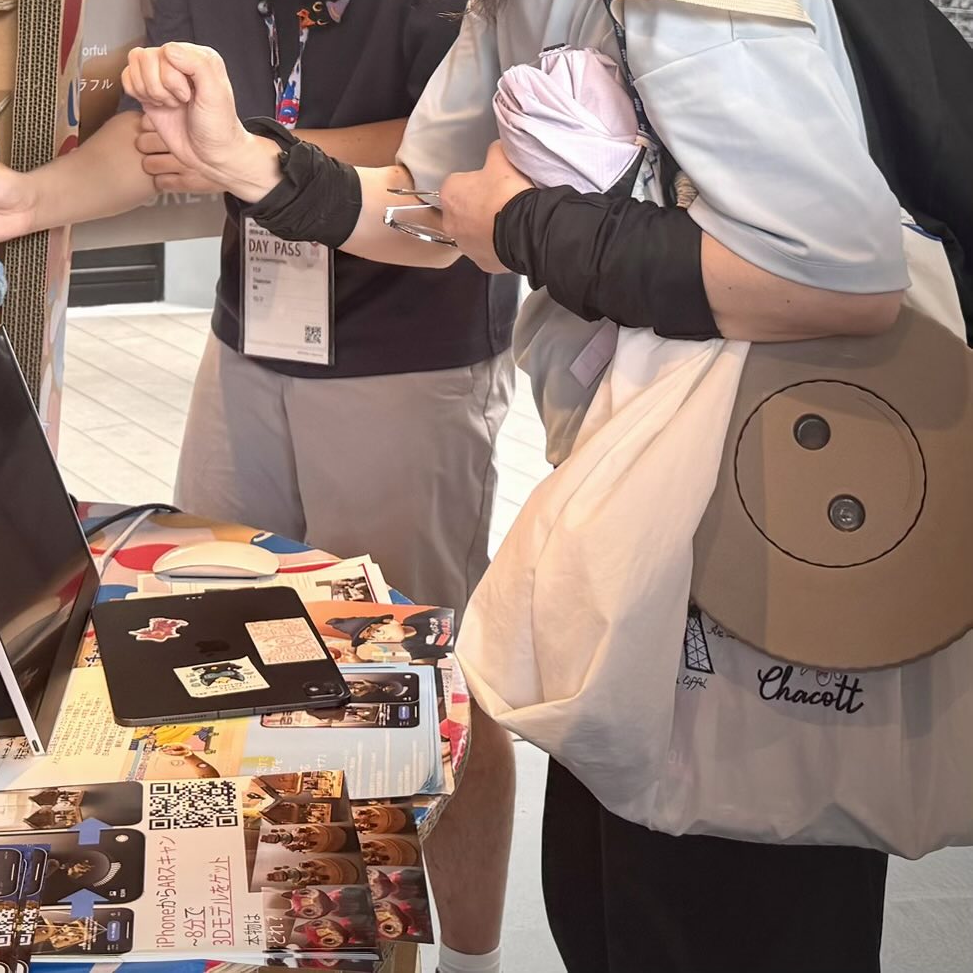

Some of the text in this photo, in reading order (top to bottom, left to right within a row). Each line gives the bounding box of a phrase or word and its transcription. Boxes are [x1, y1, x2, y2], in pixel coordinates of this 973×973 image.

[82, 44, 108, 56] orful
[78, 78, 114, 91] ラフル
[248, 239, 302, 257] DAY PASS
[757, 665, 865, 714] Chacott
[156, 835, 178, 948] iPhoneからARスキャン
[208, 856, 233, 946] 3Dモデルをゲット
[244, 913, 263, 945] 本物は
